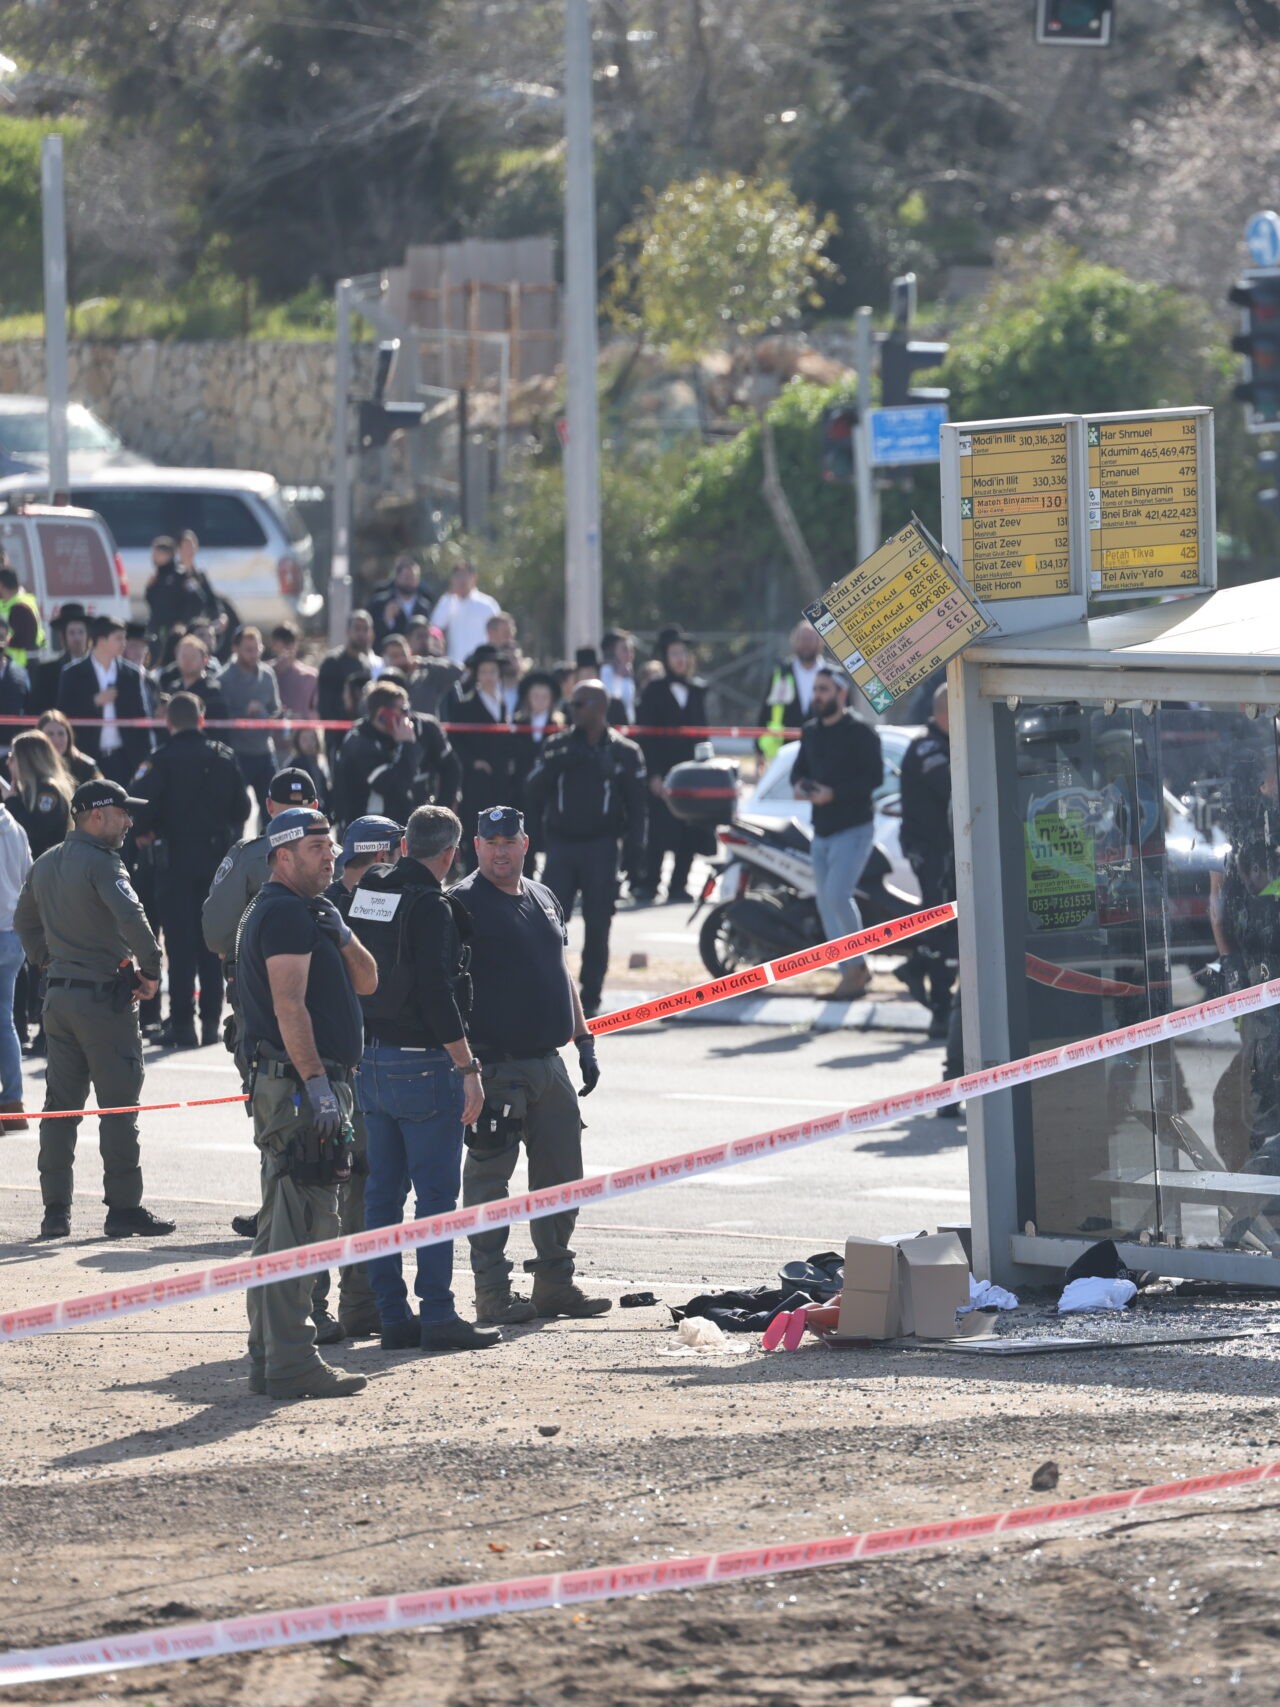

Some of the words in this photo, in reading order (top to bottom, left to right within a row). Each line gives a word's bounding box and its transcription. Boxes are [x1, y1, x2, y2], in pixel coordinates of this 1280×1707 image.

[1101, 432, 1116, 440] Har
[1119, 428, 1152, 438] Shmuel
[1182, 425, 1196, 434] 138
[972, 435, 1002, 445] Modi'in
[1004, 434, 1015, 443] Illit
[1019, 434, 1066, 447] 310,316,320
[1101, 447, 1139, 457] Kdumim
[1141, 446, 1196, 459] 465,469,475
[1050, 455, 1066, 464] 326
[1101, 467, 1139, 478] Emanuel
[1179, 467, 1197, 475] 479
[973, 477, 1004, 487] Modi'in
[1006, 476, 1018, 485] Illit
[1033, 476, 1067, 487] 330,336
[1101, 490, 1129, 498] Mateh
[1131, 486, 1173, 497] Binyamin
[1183, 488, 1197, 496] 136
[1003, 497, 1038, 507] Binyamin
[1042, 496, 1061, 508] 130
[1102, 510, 1120, 519] Bnei
[1123, 509, 1141, 517] Brak
[1145, 508, 1197, 522] 421,422,423
[974, 519, 997, 529] Givat
[1000, 518, 1021, 527] Zeev
[1057, 517, 1068, 526] 131
[898, 528, 915, 544] 105
[1180, 528, 1197, 538] 429
[975, 540, 997, 550] Givat
[1000, 539, 1021, 548] Zeev
[1055, 538, 1068, 547] 132
[1105, 550, 1129, 561] Petah
[1132, 549, 1154, 558] Tikva
[1180, 546, 1197, 558] 425
[975, 561, 997, 571] Givat
[1001, 560, 1022, 569] Zeev
[832, 593, 863, 619] הורדה
[860, 574, 886, 595] בלבד
[906, 541, 925, 558] 237
[1103, 572, 1117, 581] Tel
[1120, 569, 1163, 580] Aviv-Yafo
[1180, 570, 1198, 579] 428
[976, 581, 992, 592] Beit
[995, 580, 1021, 590] Horon
[1056, 580, 1069, 588] 135
[845, 606, 875, 631] מודיעין
[874, 588, 898, 608] עילית
[903, 558, 930, 582] 338
[854, 619, 884, 644] מודיעין
[882, 602, 905, 622] עילית
[907, 568, 942, 599] 318,328
[935, 597, 959, 618] 139
[863, 631, 894, 657] מודיעין
[890, 615, 915, 636] עילית
[914, 581, 952, 614] 308,348
[945, 610, 969, 631] 133
[904, 666, 929, 687] אביב
[966, 619, 983, 634] 471
[92, 797, 114, 808] POLICE
[777, 952, 821, 973] משטרת
[843, 936, 880, 951] ישראל
[899, 918, 915, 932] אין
[918, 908, 948, 924] מעבר
